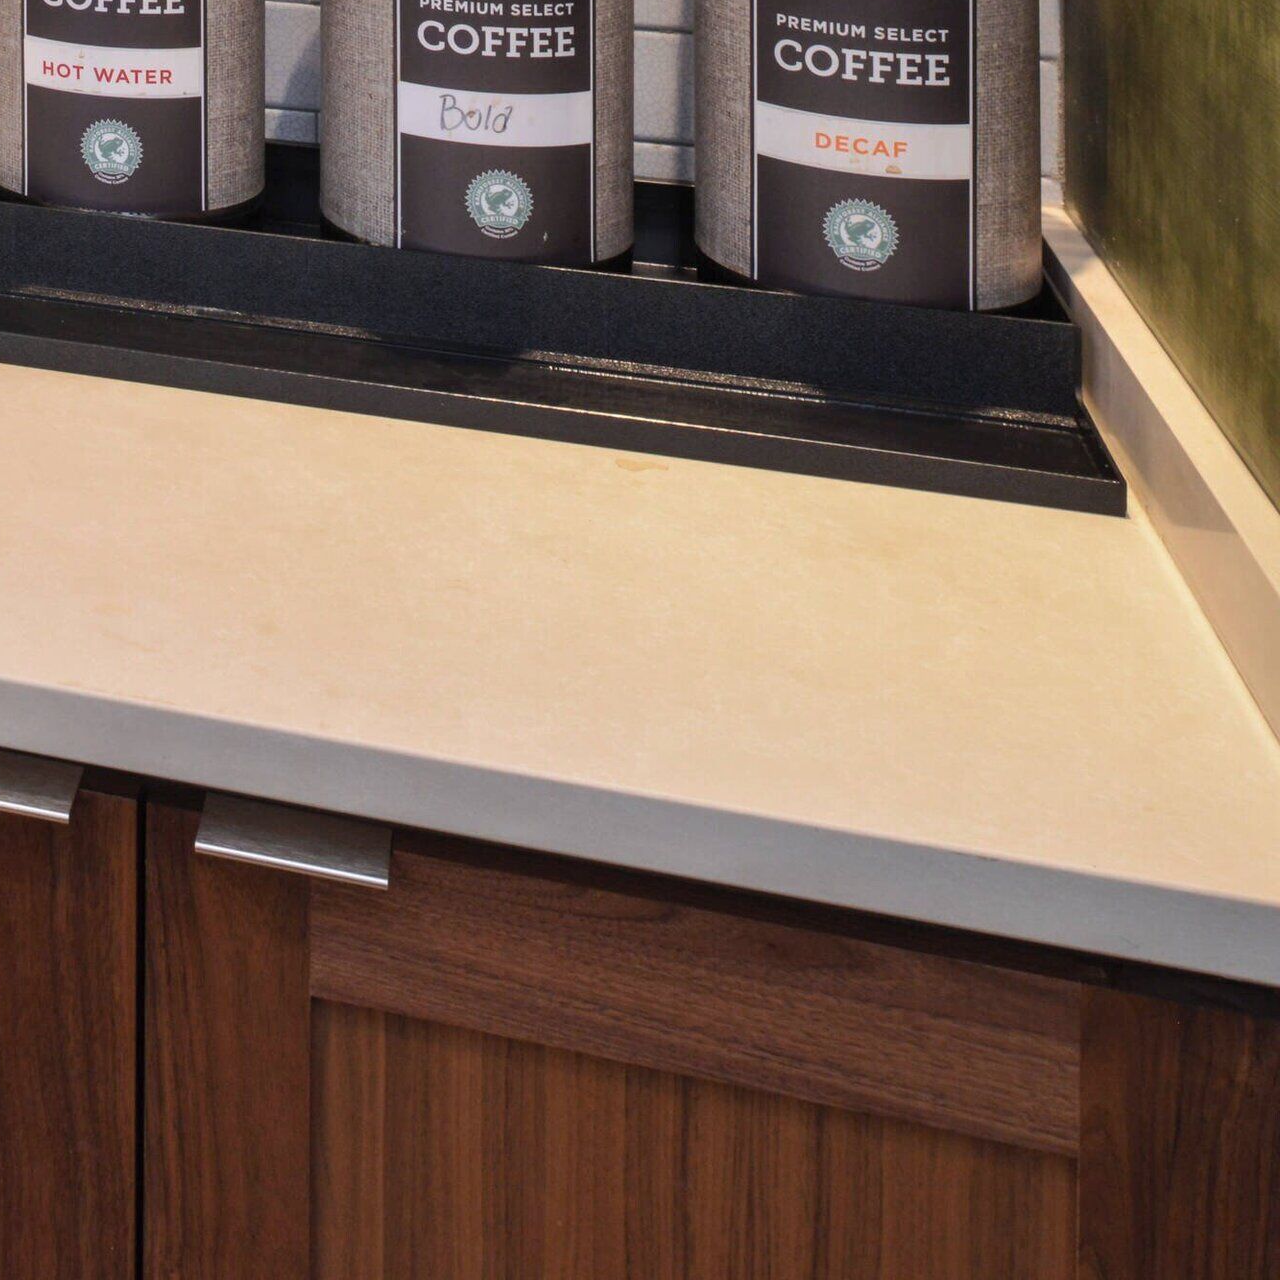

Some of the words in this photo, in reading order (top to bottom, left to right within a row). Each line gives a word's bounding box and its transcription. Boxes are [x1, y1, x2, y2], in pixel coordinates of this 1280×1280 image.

[510, 2, 575, 16] SELECT
[417, 20, 576, 58] COFFEE
[776, 13, 866, 38] PREMIUM
[874, 26, 950, 42] SELECT
[42, 60, 84, 80] HOT
[94, 67, 173, 84] WATER
[774, 39, 950, 86] COFFEE
[439, 95, 513, 134] Bold
[815, 132, 908, 158] DECAF
